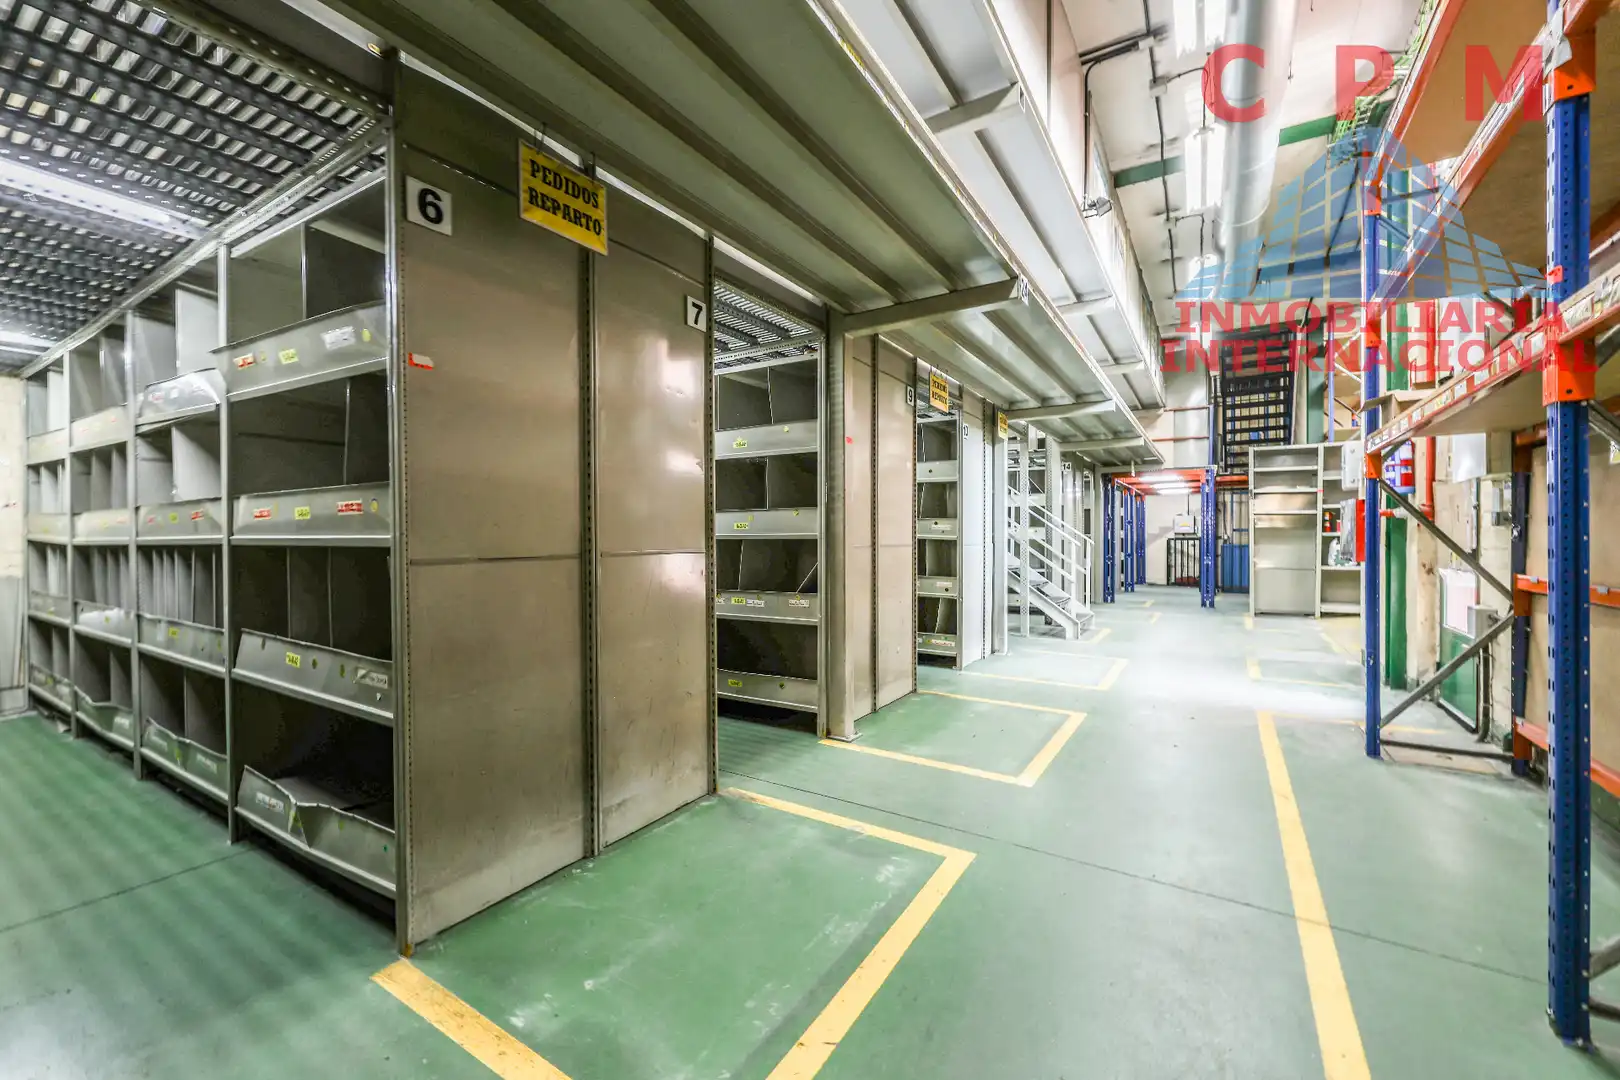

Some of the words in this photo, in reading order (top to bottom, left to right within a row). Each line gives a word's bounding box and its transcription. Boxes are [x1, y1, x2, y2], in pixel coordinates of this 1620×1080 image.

[529, 158, 599, 209] PEDIDOS
[418, 187, 444, 225] 6
[527, 185, 602, 237] REPARTO
[691, 300, 703, 326] 7
[908, 388, 913, 403] 9
[1063, 463, 1071, 471] 14
